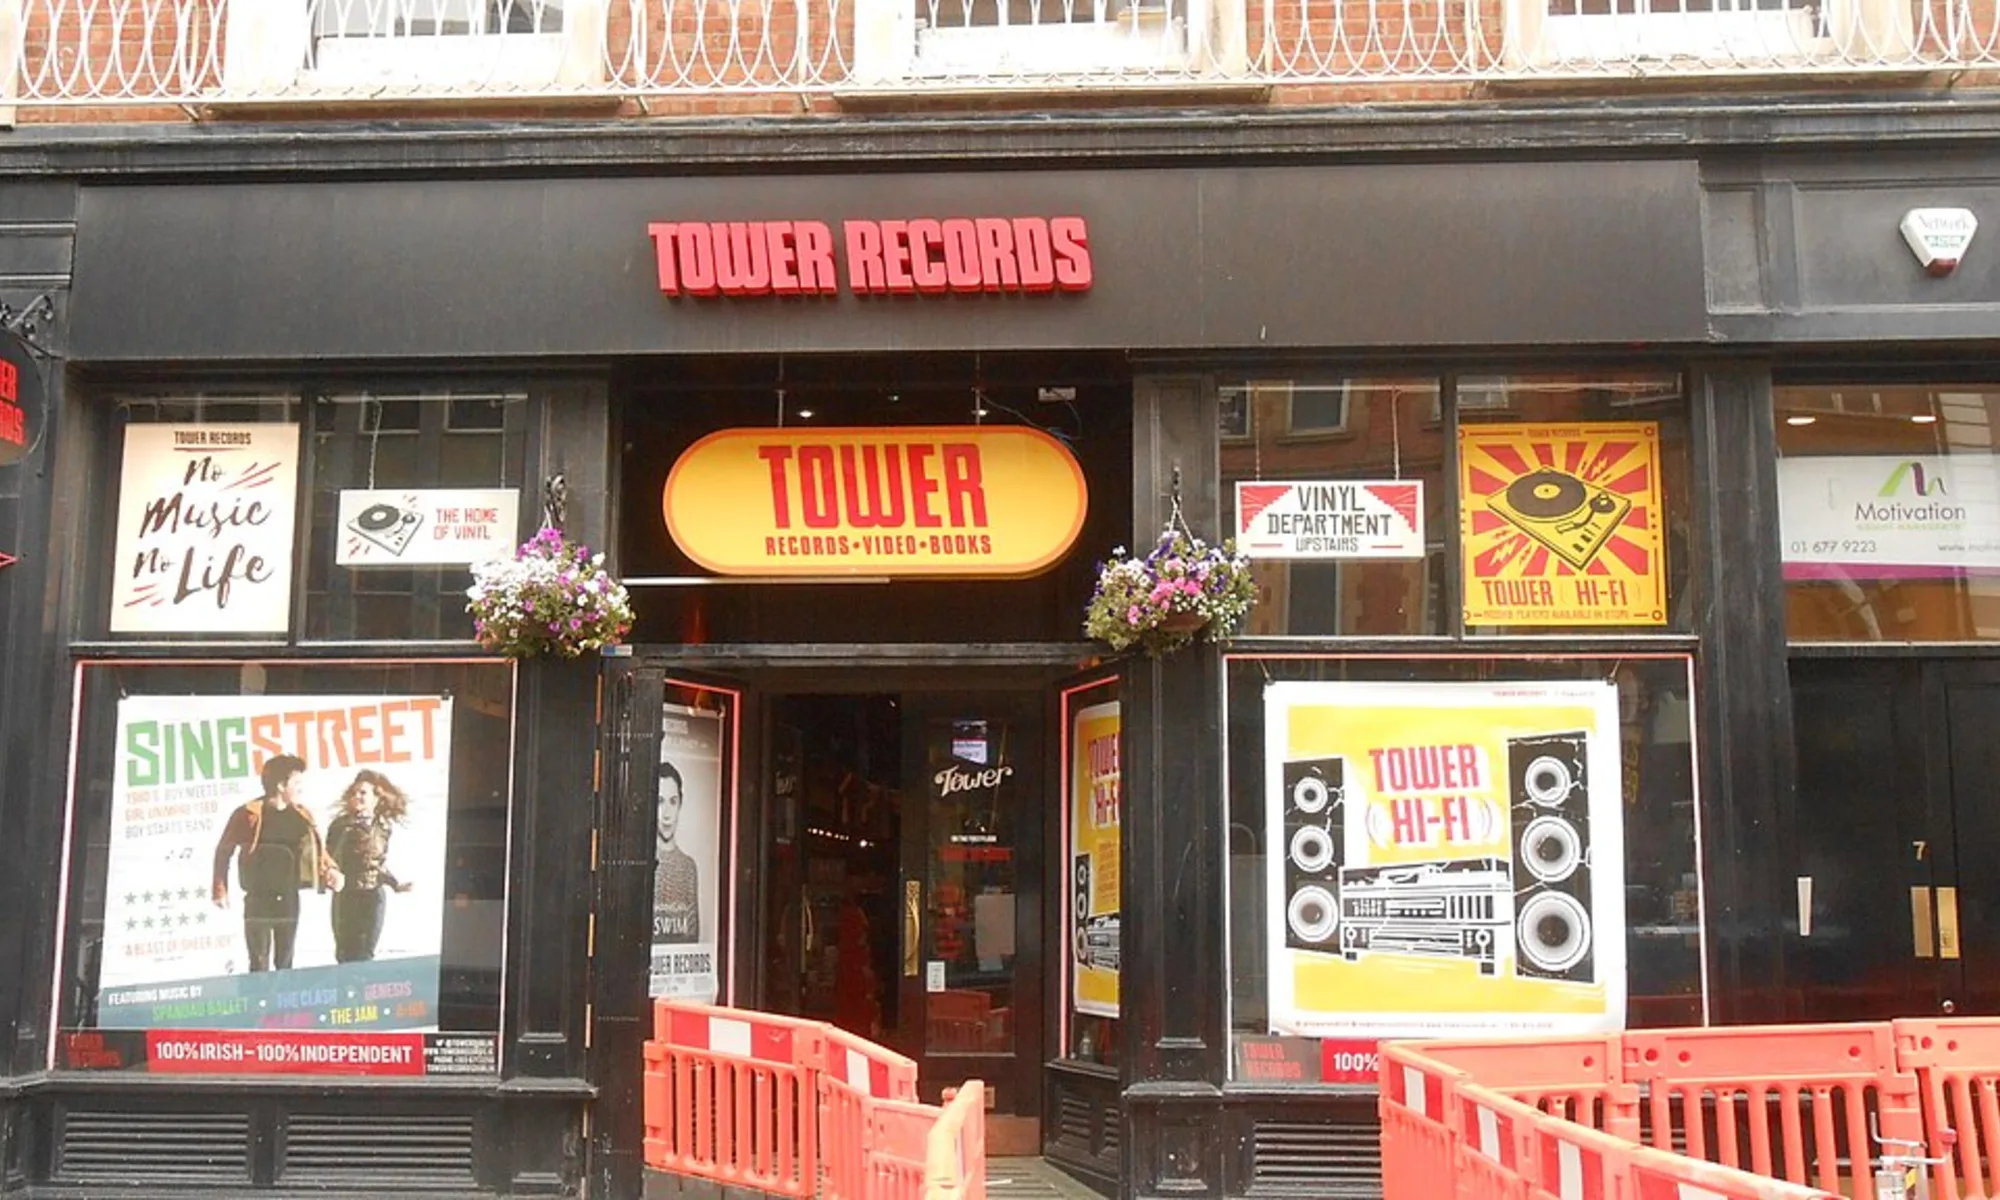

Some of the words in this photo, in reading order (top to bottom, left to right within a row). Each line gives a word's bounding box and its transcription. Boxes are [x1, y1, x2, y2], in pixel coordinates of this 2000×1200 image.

[647, 220, 838, 294] TOWER
[844, 216, 1093, 295] RECORDS
[174, 431, 208, 445] TOWER
[209, 431, 252, 445] RECORDS
[183, 456, 225, 486] No
[759, 442, 989, 530] TOWER
[1297, 485, 1366, 512] VINYL
[138, 491, 272, 539] Music
[436, 508, 460, 523] THE
[464, 508, 499, 523] HOME
[1855, 502, 1966, 522] Motivation
[433, 525, 453, 541] OF
[454, 525, 491, 541] VINYL
[1267, 512, 1393, 537] DEPARTMENT
[765, 535, 848, 556] RECORDS
[859, 535, 918, 555] VIDEO
[930, 534, 992, 555] BOOKS
[1295, 535, 1360, 553] UPSTAIRS
[1790, 540, 1808, 553] 01
[1812, 540, 1839, 554] 677
[1842, 539, 1877, 554] 9223
[133, 547, 175, 579] No
[173, 543, 274, 609] Life
[1481, 579, 1555, 606] TOWER
[1575, 579, 1629, 606] HI-FI
[1088, 733, 1120, 778] TOWE
[1368, 743, 1481, 793] TOWER
[934, 764, 1013, 797] Tower
[1390, 796, 1472, 843] HI-FI
[1913, 840, 1927, 861] 7
[653, 916, 688, 936] SWIM
[673, 953, 711, 974] RECORDS
[108, 988, 158, 1006] FEATURING
[159, 985, 189, 1001] MUSIC
[190, 985, 203, 998] BY
[301, 988, 338, 1007] CLASH
[330, 1007, 352, 1025] THE
[354, 1005, 379, 1023] JAM
[155, 1041, 199, 1060] 100%
[200, 1043, 244, 1061] IRISH
[256, 1043, 299, 1062] 100%
[300, 1044, 412, 1064] INDEPENDENT
[1242, 1042, 1285, 1060] TOWER
[1245, 1061, 1302, 1079] RECORDS
[1333, 1052, 1379, 1072] 100%
